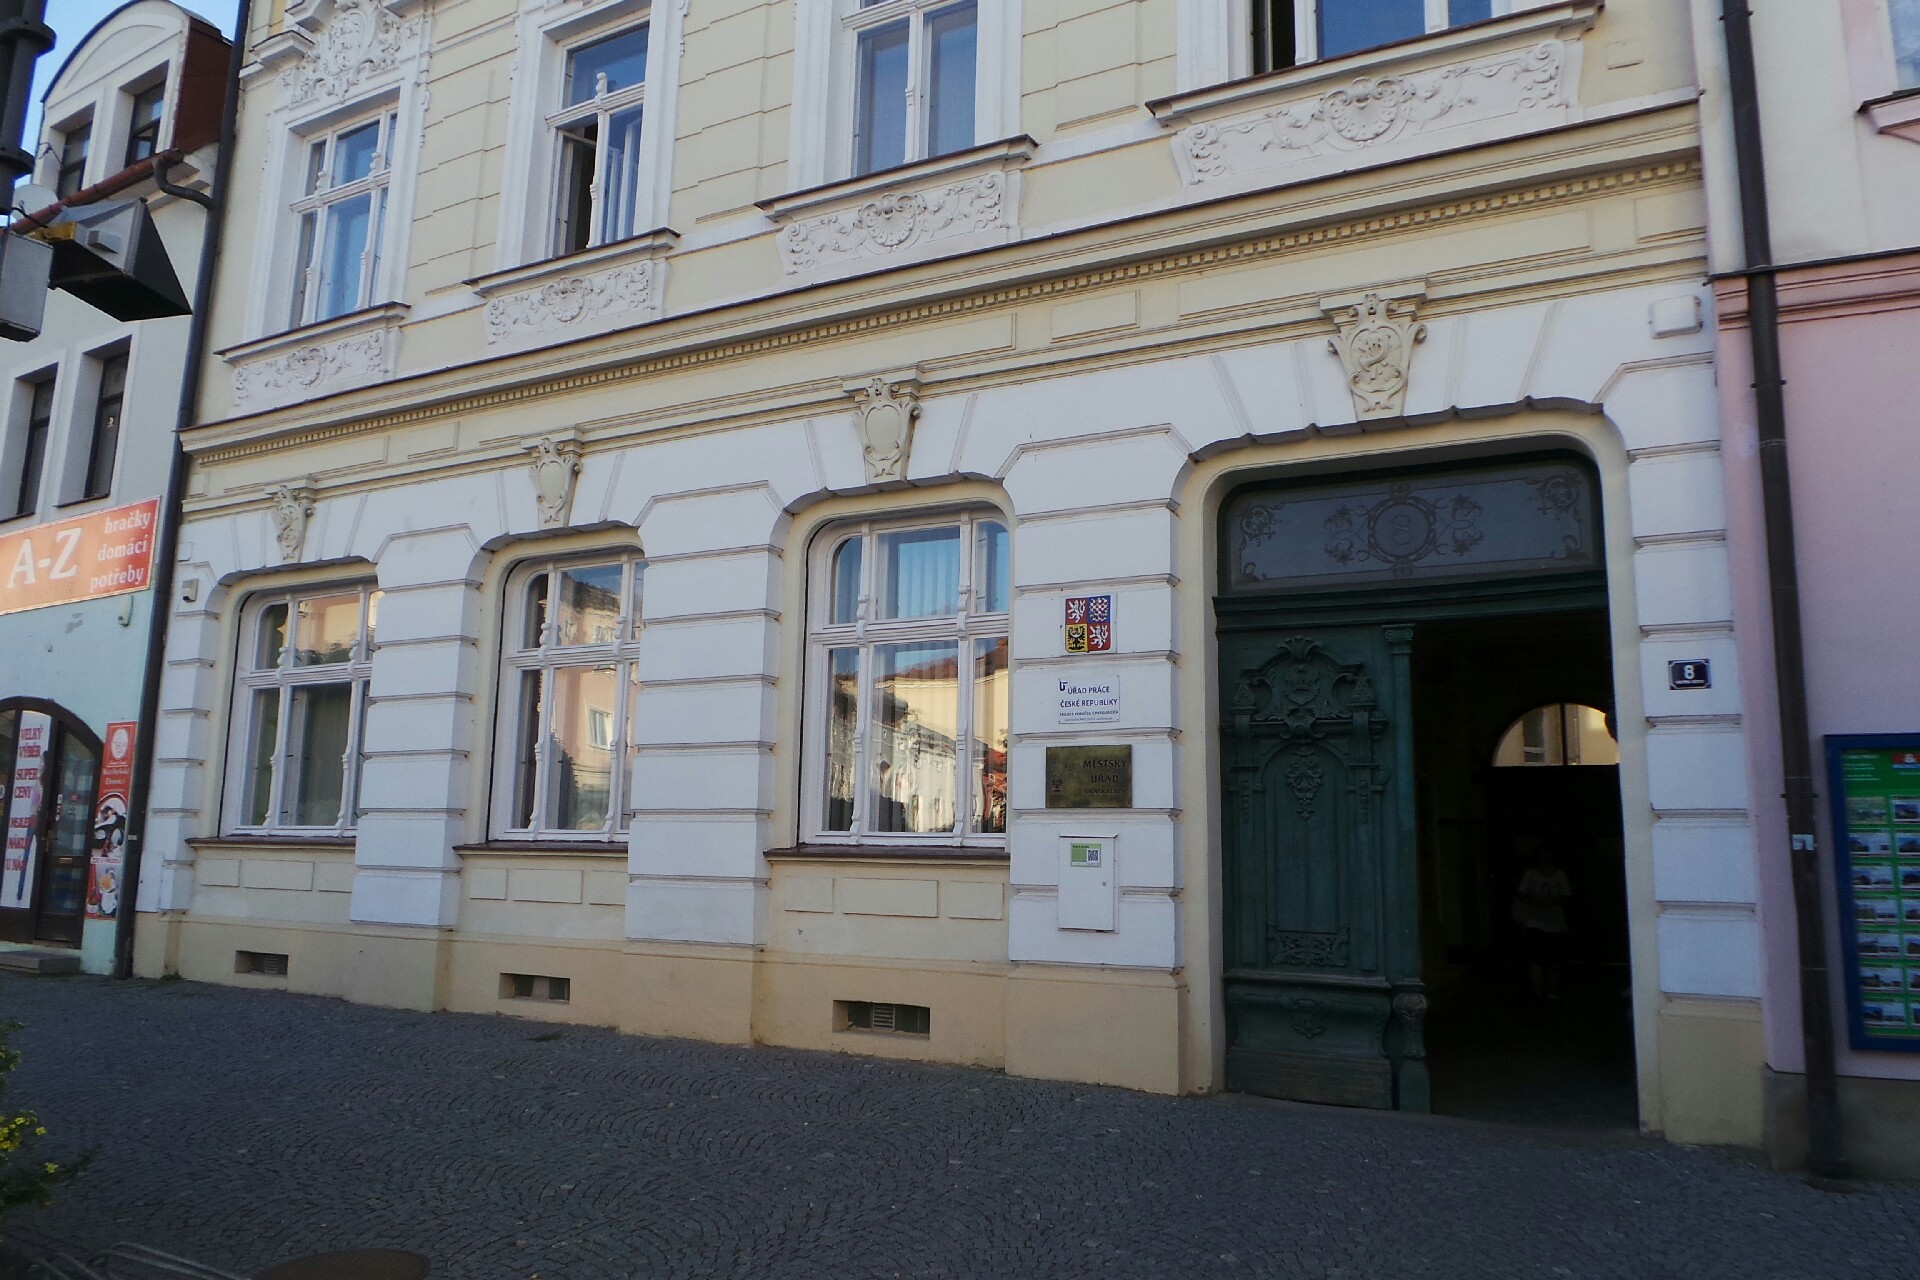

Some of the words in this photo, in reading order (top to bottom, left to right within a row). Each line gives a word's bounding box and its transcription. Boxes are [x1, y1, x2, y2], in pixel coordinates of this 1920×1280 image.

[105, 510, 151, 534] hračky
[98, 535, 148, 561] domácí
[6, 527, 83, 589] A-Z
[89, 565, 144, 594] potřeby
[1684, 664, 1695, 679] 8
[1067, 685, 1087, 695] ÚŘAD
[1088, 684, 1110, 694] PRÁCE
[1060, 699, 1080, 708] ČESKÉ
[1081, 698, 1118, 707] REPUBLIKY
[20, 724, 44, 740] VELKÝ
[18, 742, 41, 758] VÝBĚR
[14, 786, 33, 799] CENY
